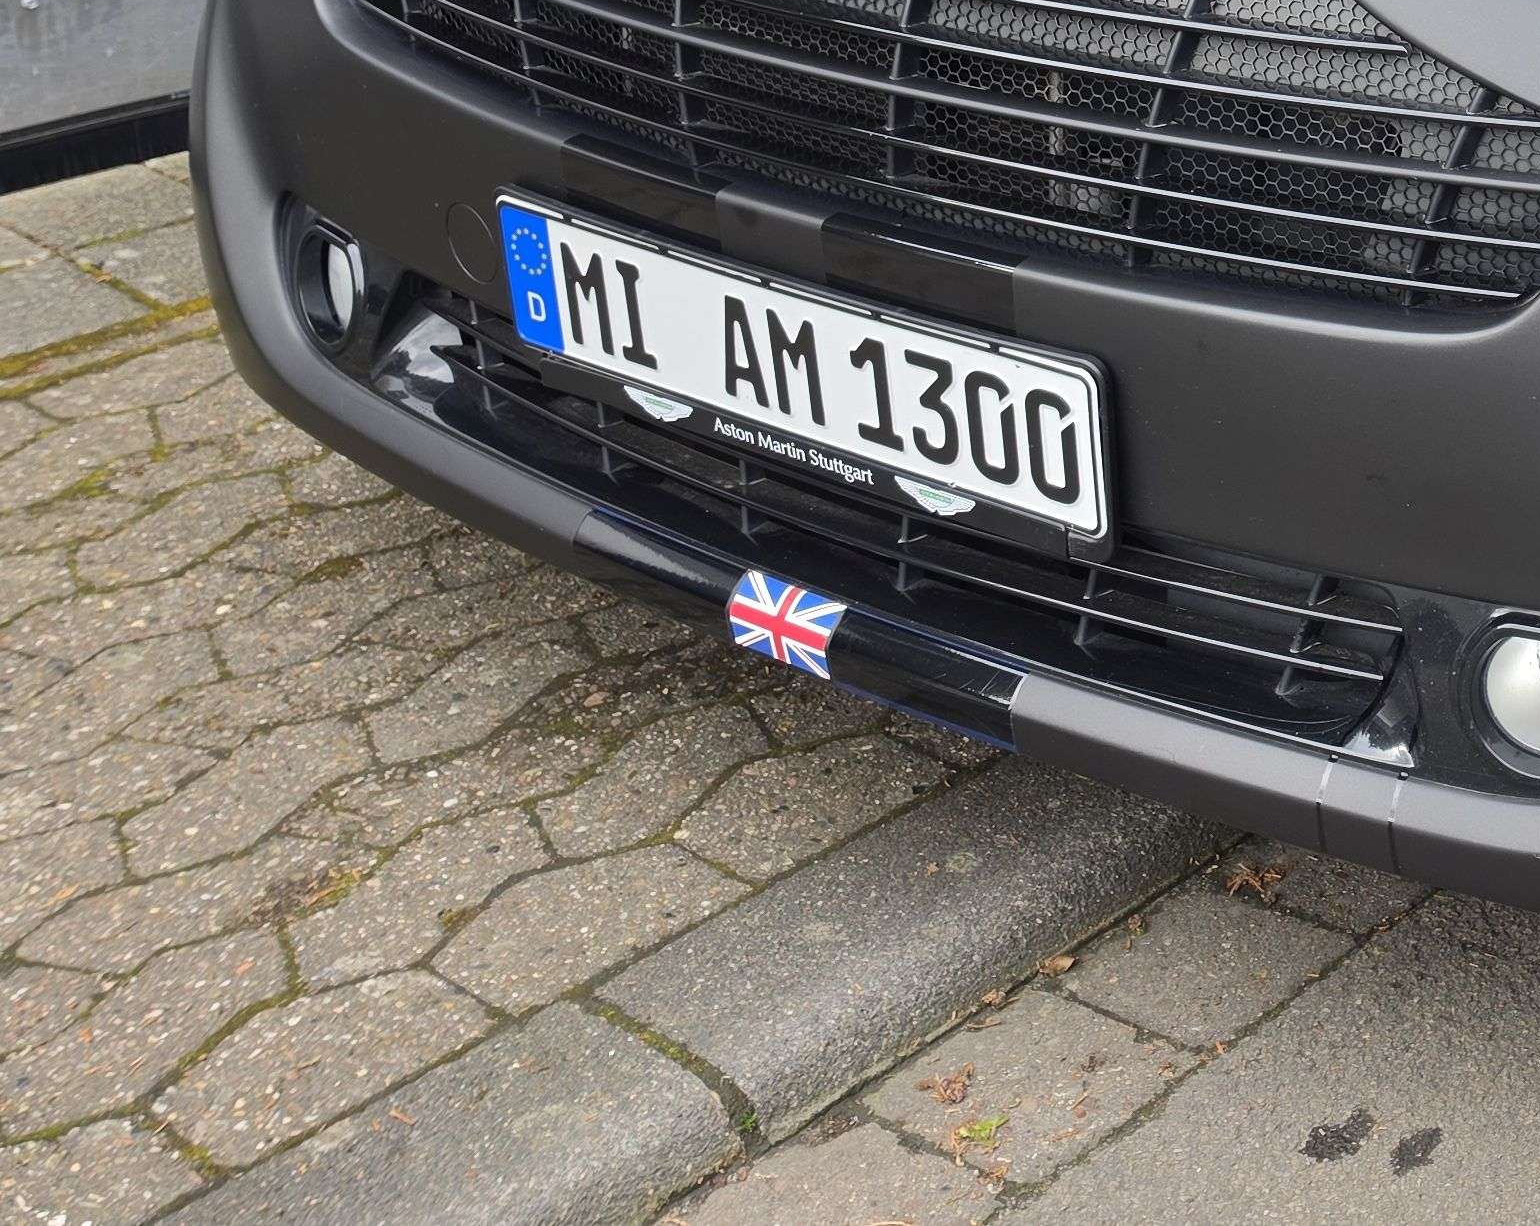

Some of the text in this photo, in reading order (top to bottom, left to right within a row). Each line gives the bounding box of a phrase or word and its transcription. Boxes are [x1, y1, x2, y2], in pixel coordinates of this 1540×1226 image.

[526, 289, 548, 322] D
[560, 241, 1081, 505] MI AM 1300
[713, 416, 875, 486] Aston Martin Stuttgart
